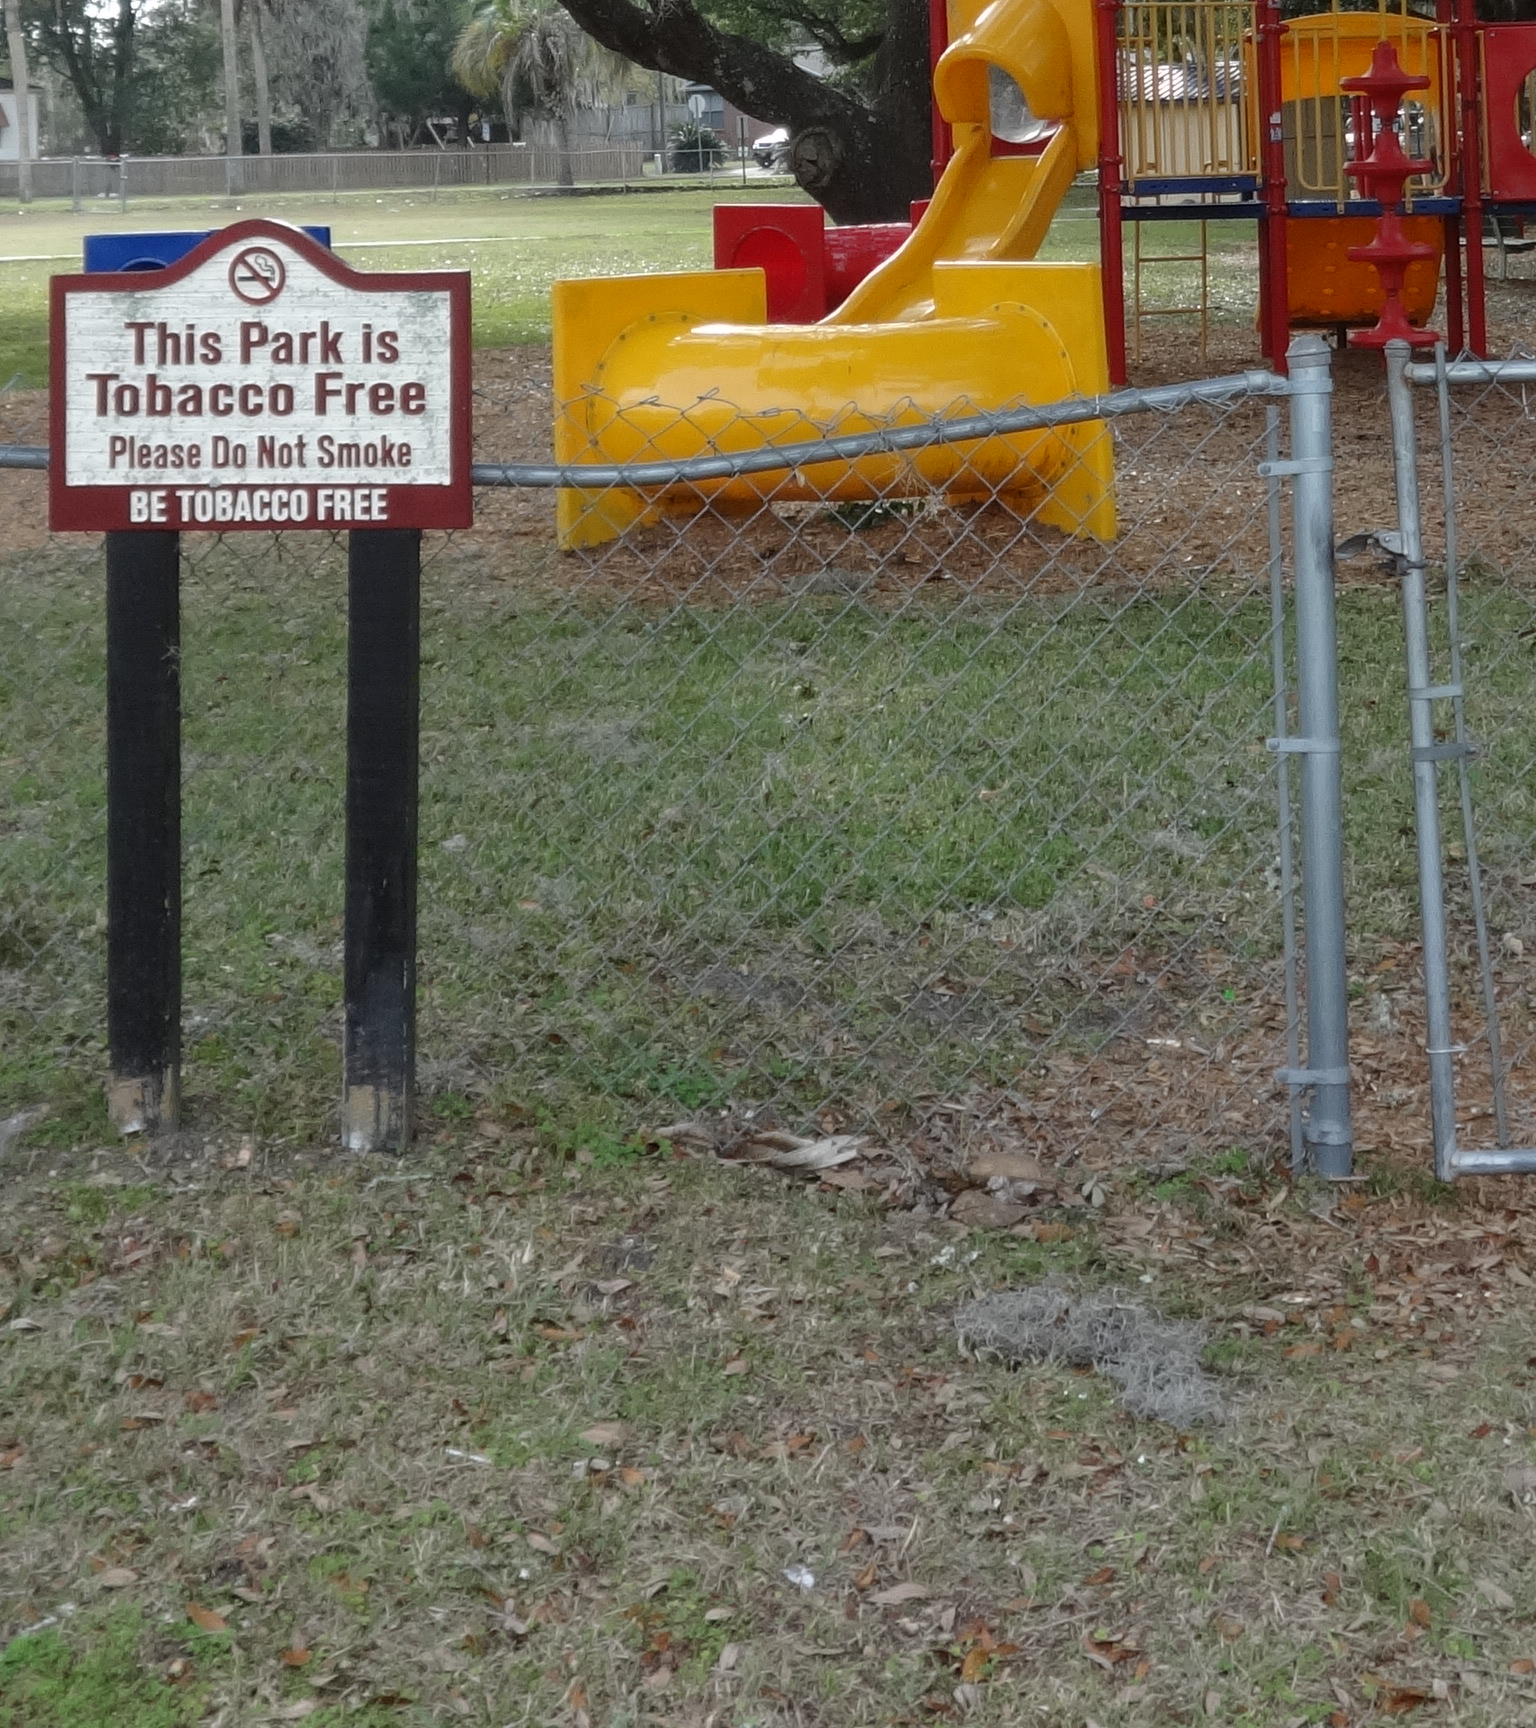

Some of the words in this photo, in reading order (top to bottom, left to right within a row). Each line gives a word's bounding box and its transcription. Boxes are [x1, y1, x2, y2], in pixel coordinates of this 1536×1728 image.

[126, 322, 222, 365] This
[239, 321, 344, 365] Park
[361, 323, 399, 364] is
[86, 373, 294, 417] Tobacco
[314, 372, 426, 416] Free
[109, 436, 201, 469] Please
[212, 436, 247, 469] Do
[257, 436, 307, 469] Not
[317, 435, 412, 468] Smoke
[130, 490, 166, 523] BE
[176, 490, 308, 522] TOBACCO
[317, 489, 388, 521] FREE
